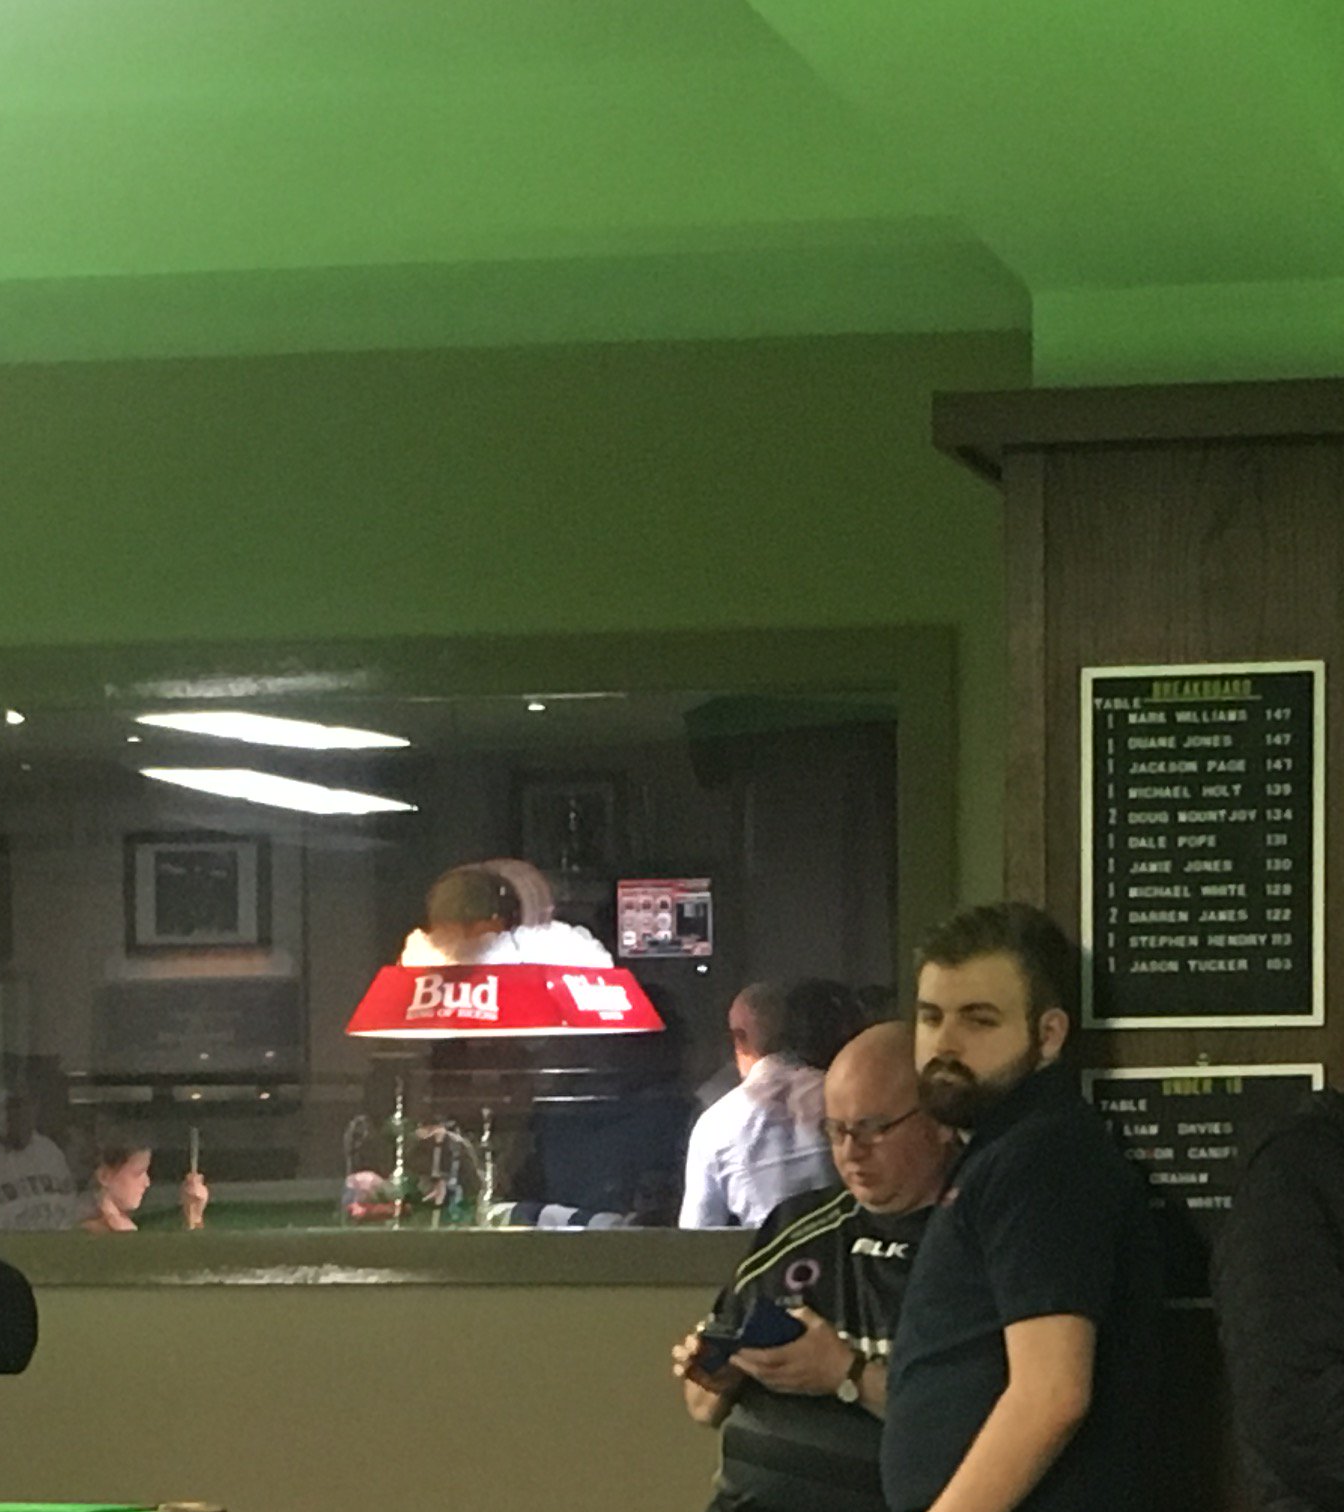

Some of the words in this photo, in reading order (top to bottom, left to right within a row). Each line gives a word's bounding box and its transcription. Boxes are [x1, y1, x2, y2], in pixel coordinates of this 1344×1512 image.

[1128, 712, 1166, 724] MARK
[1175, 710, 1247, 722] WILLIAMS
[1266, 708, 1291, 720] 147
[1183, 735, 1232, 748] JONES
[1266, 733, 1291, 745] 147
[1129, 761, 1197, 774] JACKSON
[1267, 758, 1292, 771] 147
[1129, 786, 1190, 798] MICHAEL
[1266, 809, 1292, 820] 134
[1128, 836, 1166, 848] DALE
[1184, 860, 1232, 872] JONES
[1129, 885, 1190, 898] MICHAEL
[1129, 910, 1188, 923] DARREN
[1129, 936, 1198, 948] STEPHEN
[408, 974, 498, 1011] Bud
